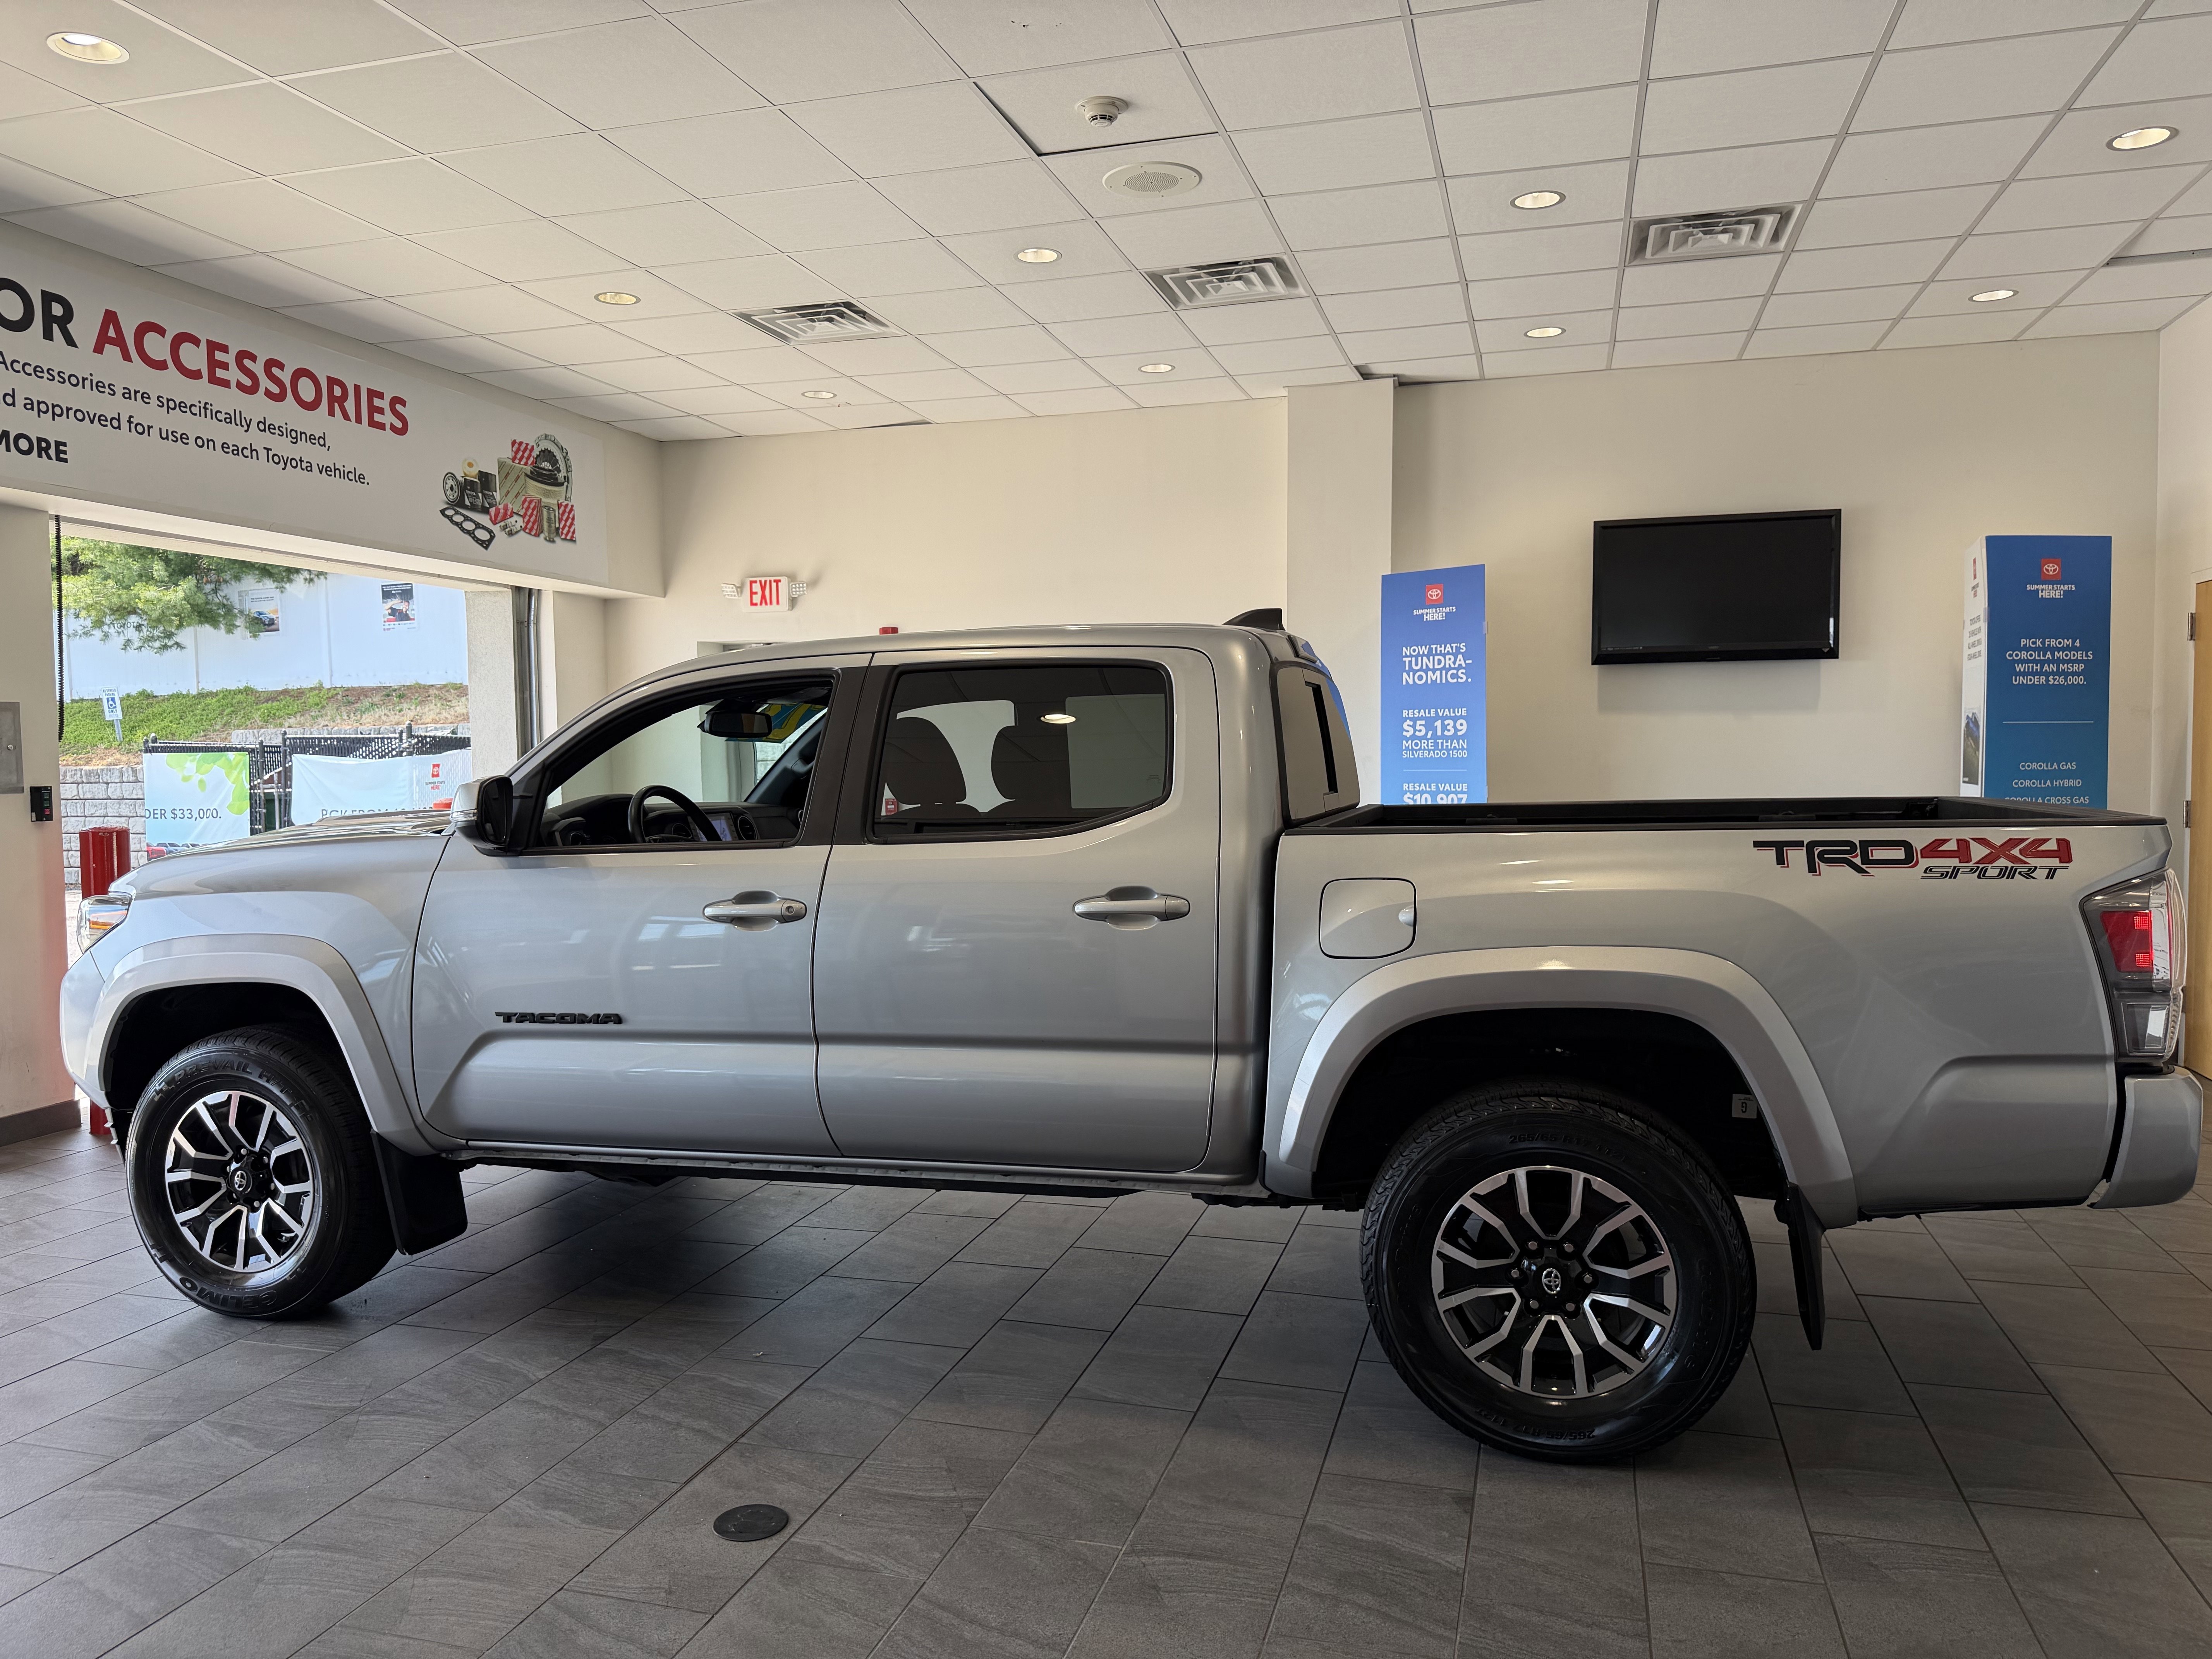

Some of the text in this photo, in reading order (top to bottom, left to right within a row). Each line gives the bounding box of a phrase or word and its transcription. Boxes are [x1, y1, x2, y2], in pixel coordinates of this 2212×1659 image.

[92, 308, 409, 436] ACCESSORIES
[122, 386, 151, 405] are
[156, 394, 252, 433] specifically
[257, 417, 331, 451] designed,
[0, 388, 369, 485] d approved for use on each Toyota vehicle.
[749, 579, 781, 606] EXIT
[2039, 590, 2063, 598] HERE!
[1424, 612, 1445, 621] HERE!
[1403, 643, 1466, 656] NOW THAT'S
[2020, 639, 2080, 648] PICK FROM 4
[2006, 651, 2093, 660] COROLLA MODELS
[1403, 655, 1472, 670] TUNDRA-
[2015, 663, 2085, 673] WITH AN MSRP
[1403, 670, 1472, 685] NOMICS.
[2012, 675, 2087, 685] UNDER $26,000.
[1403, 708, 1467, 717] RESALE VALUE
[1402, 719, 1467, 737] $5,139
[1403, 739, 1467, 749] MORE THAN
[1402, 750, 1467, 758] SILVERADO 1500
[2020, 762, 2058, 770] COROLLA
[1439, 783, 1468, 791] VALUE
[1403, 792, 1468, 805] $10907
[171, 807, 222, 821] $33,000.
[1753, 837, 2073, 877] TRD 4X4
[1920, 866, 2069, 880] SPORT
[495, 1012, 623, 1025] TACOMA
[174, 1059, 252, 1084] PREVAIL
[1508, 1132, 1558, 1144] 265/65
[179, 1277, 277, 1309] CELIMO
